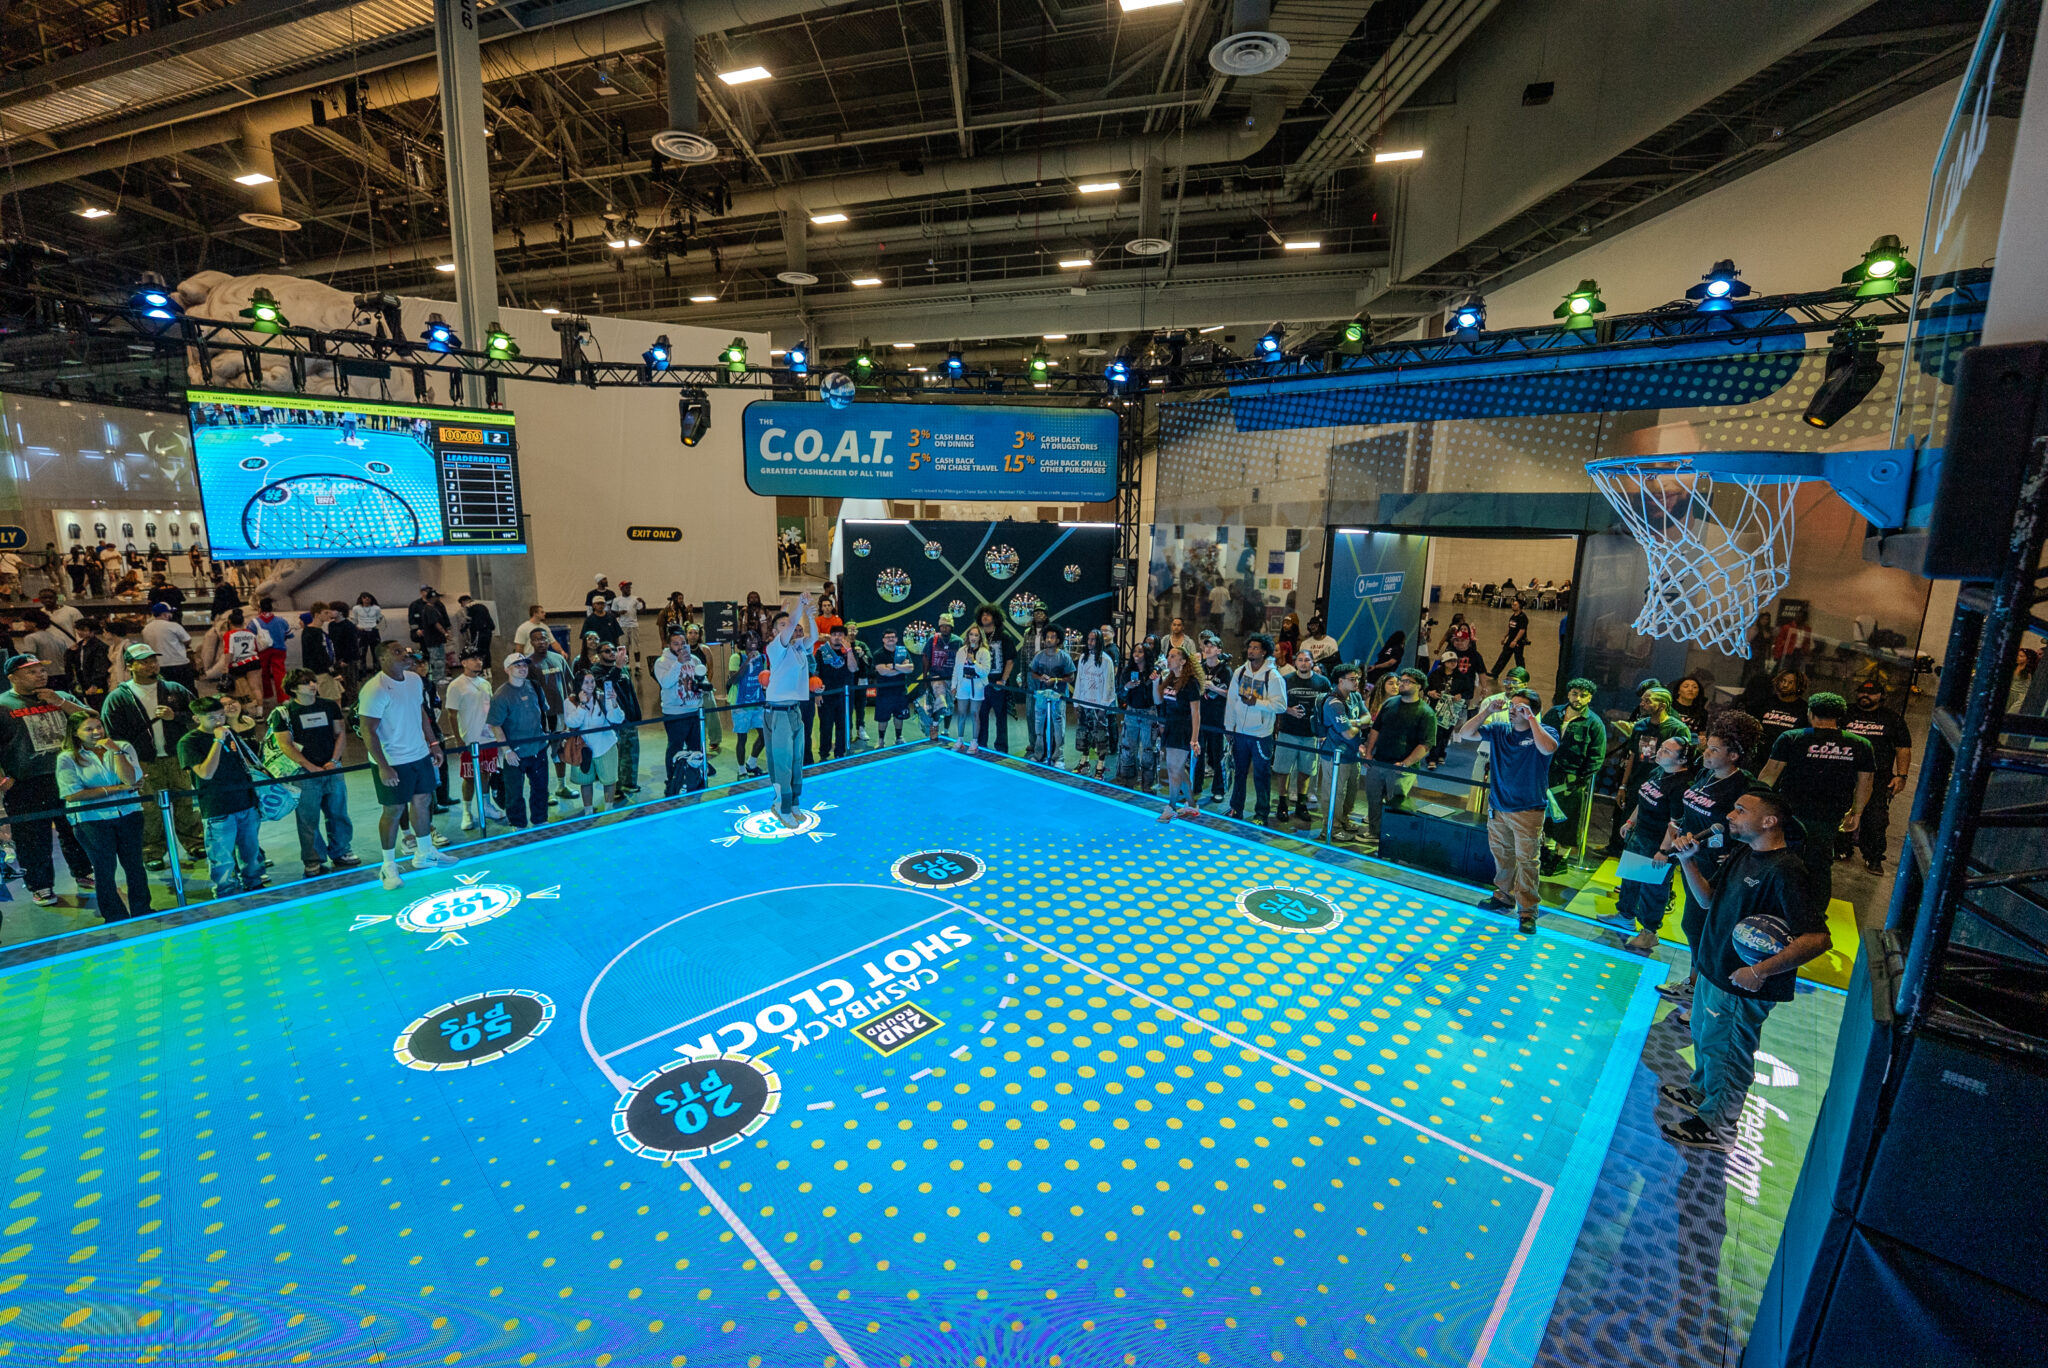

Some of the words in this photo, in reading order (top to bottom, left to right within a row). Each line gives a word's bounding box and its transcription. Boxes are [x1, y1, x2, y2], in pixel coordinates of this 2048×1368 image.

[493, 434, 501, 443] 2
[760, 428, 894, 464] C.O.A.T.
[908, 429, 930, 447] 3%
[1012, 431, 1035, 449] 3%
[446, 454, 506, 463] LEADERBOARD
[908, 453, 931, 470] 5%
[798, 468, 847, 476] CASHBACKER
[0, 532, 17, 543] LY
[653, 530, 677, 538] ONLY
[241, 642, 249, 654] 2
[1808, 745, 1853, 756] C.O.A.T.
[912, 856, 948, 872] PTS
[927, 861, 964, 880] 50
[425, 896, 500, 924] 100
[433, 892, 482, 911] PTS
[1259, 894, 1292, 914] PTS
[1280, 900, 1318, 922] 20
[862, 925, 973, 988] SHOT
[440, 1002, 504, 1037] PTS
[674, 978, 855, 1058] CLOCK
[782, 968, 938, 1052] CASHBACK
[866, 1008, 913, 1036] ROUND
[877, 1004, 927, 1046] 2ND
[450, 1018, 513, 1052] 50
[654, 1068, 725, 1115] PTS
[674, 1082, 743, 1134] 20
